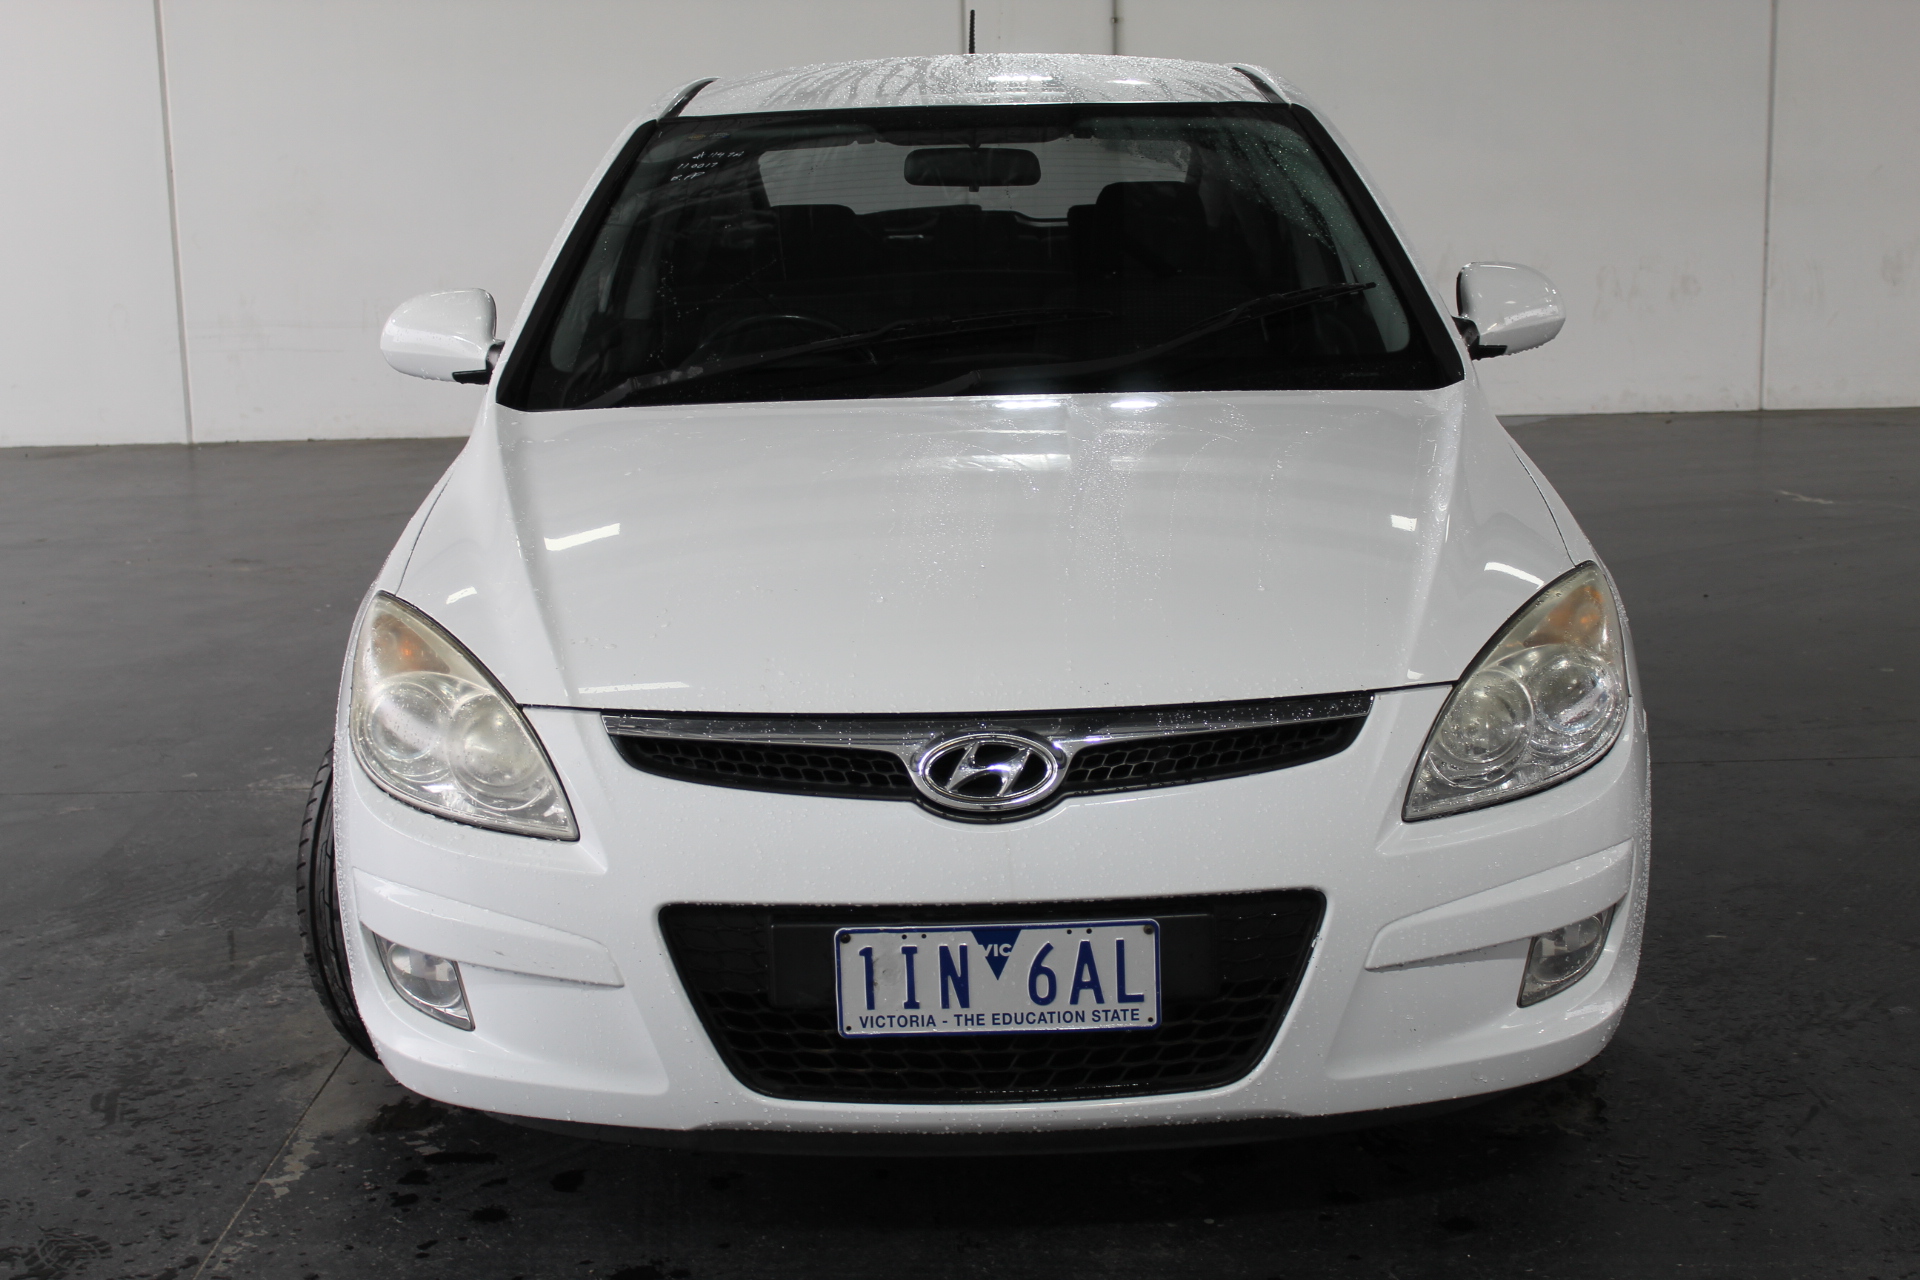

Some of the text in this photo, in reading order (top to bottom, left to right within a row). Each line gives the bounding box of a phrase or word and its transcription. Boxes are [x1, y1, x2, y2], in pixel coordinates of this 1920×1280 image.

[981, 943, 1012, 957] VIC
[1028, 937, 1145, 1006] 6AL
[859, 1014, 936, 1028] VICTORIA
[954, 1013, 986, 1027] THE
[991, 1010, 1090, 1026] EDUCATION
[1091, 1008, 1140, 1023] STATE
